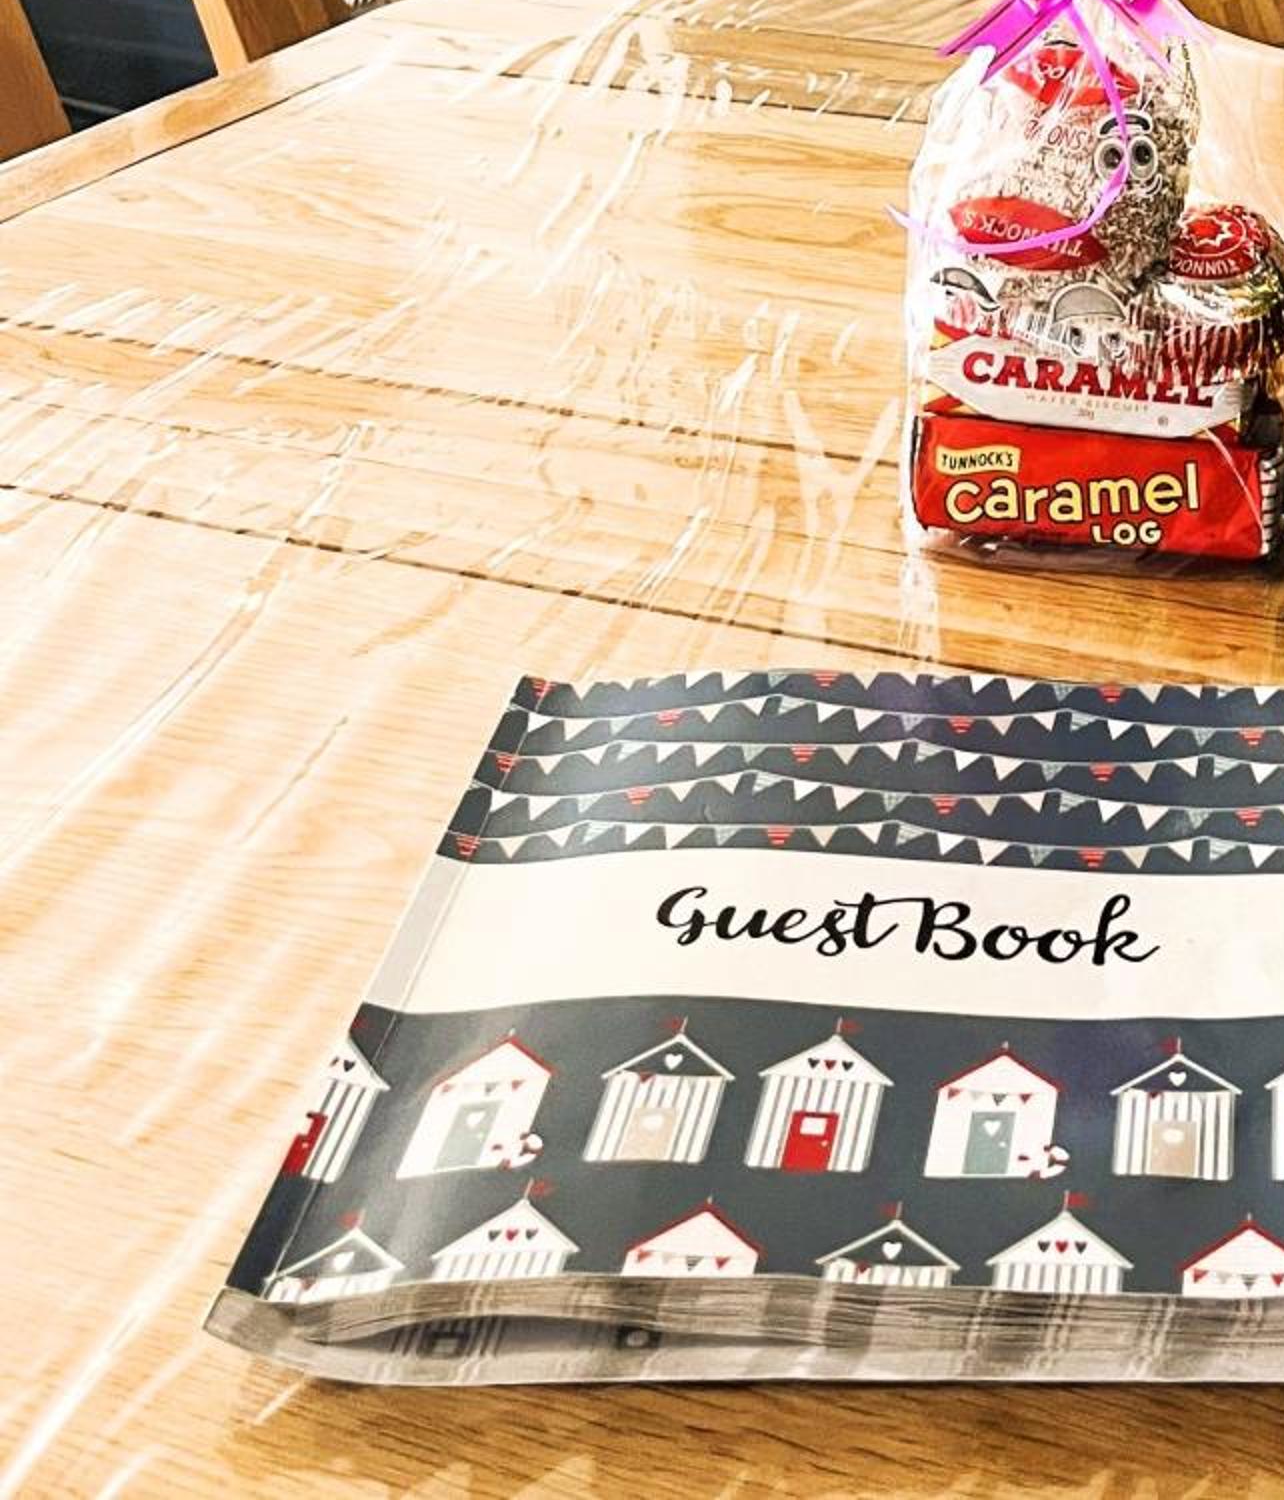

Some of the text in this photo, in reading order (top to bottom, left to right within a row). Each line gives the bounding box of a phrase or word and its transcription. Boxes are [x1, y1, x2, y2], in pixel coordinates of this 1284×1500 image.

[940, 449, 1015, 470] TUNNOCK'S
[1092, 520, 1162, 546] LOG
[656, 885, 1161, 967] Guest Book
